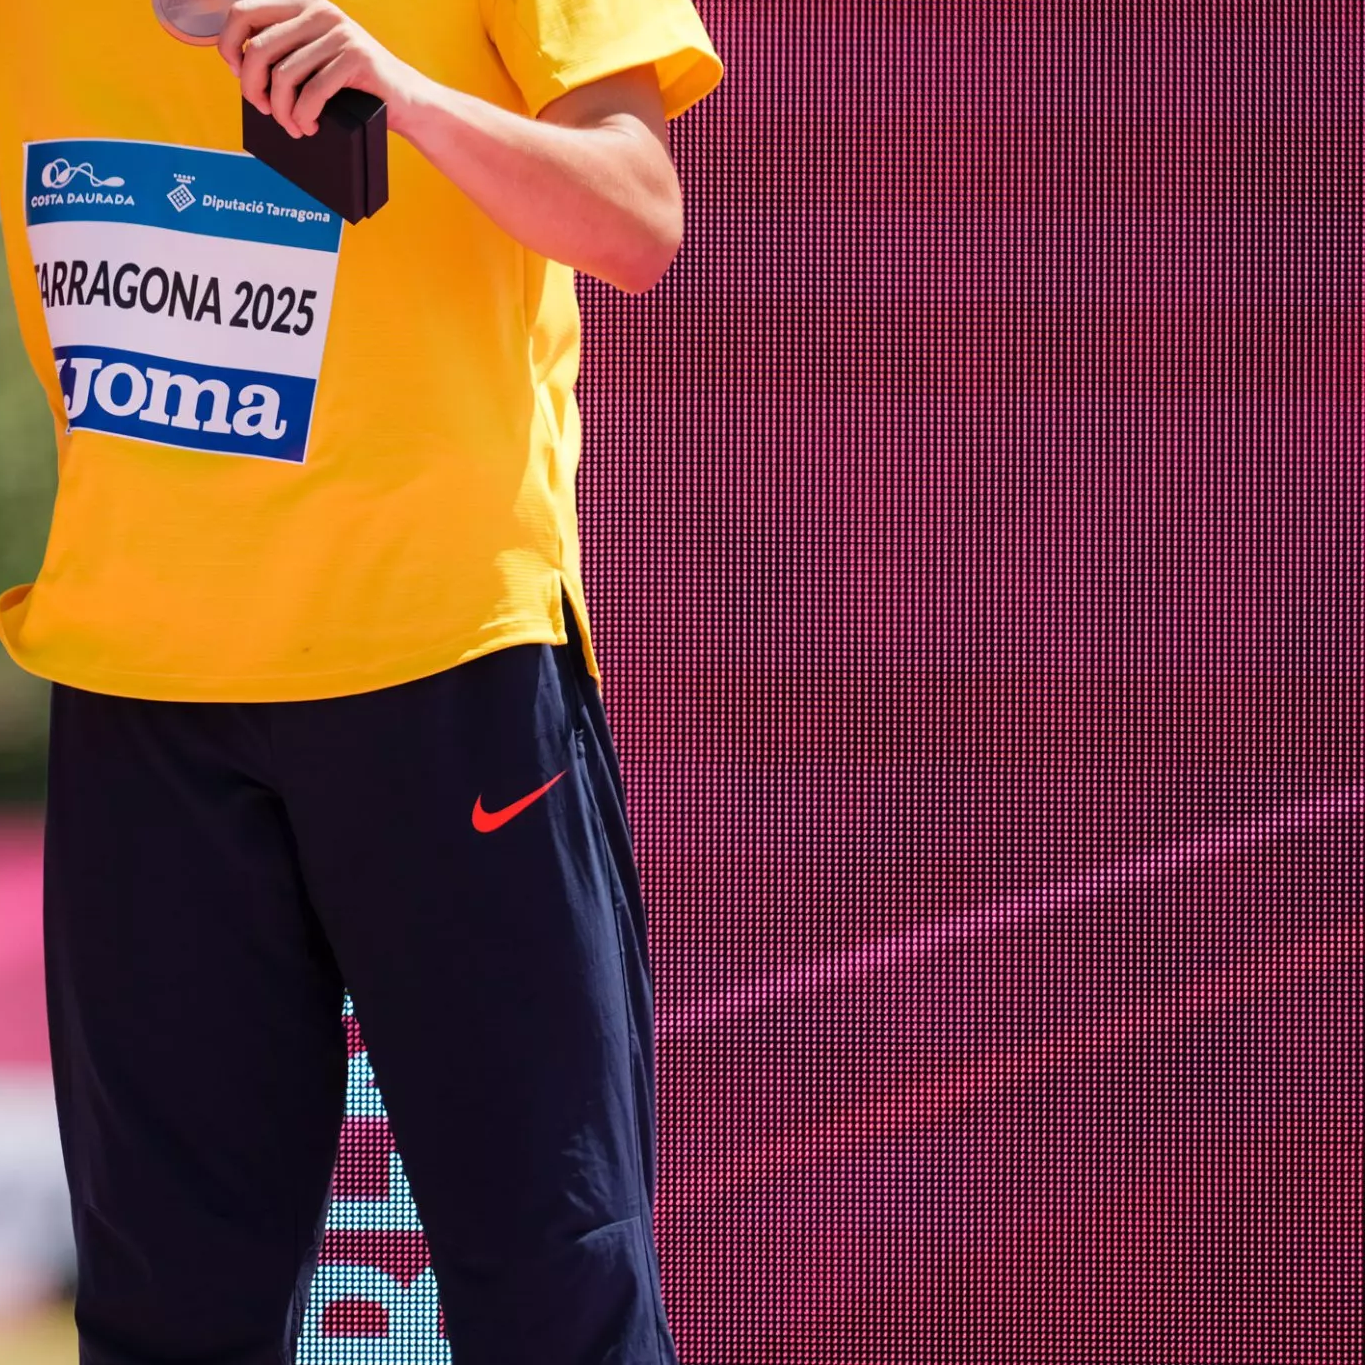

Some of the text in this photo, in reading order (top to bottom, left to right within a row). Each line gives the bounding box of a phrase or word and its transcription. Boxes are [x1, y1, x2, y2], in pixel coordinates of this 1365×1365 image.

[31, 192, 136, 208] COSTA DAURADA
[202, 194, 331, 223] Diputació Tarragona
[229, 280, 318, 337] 2025
